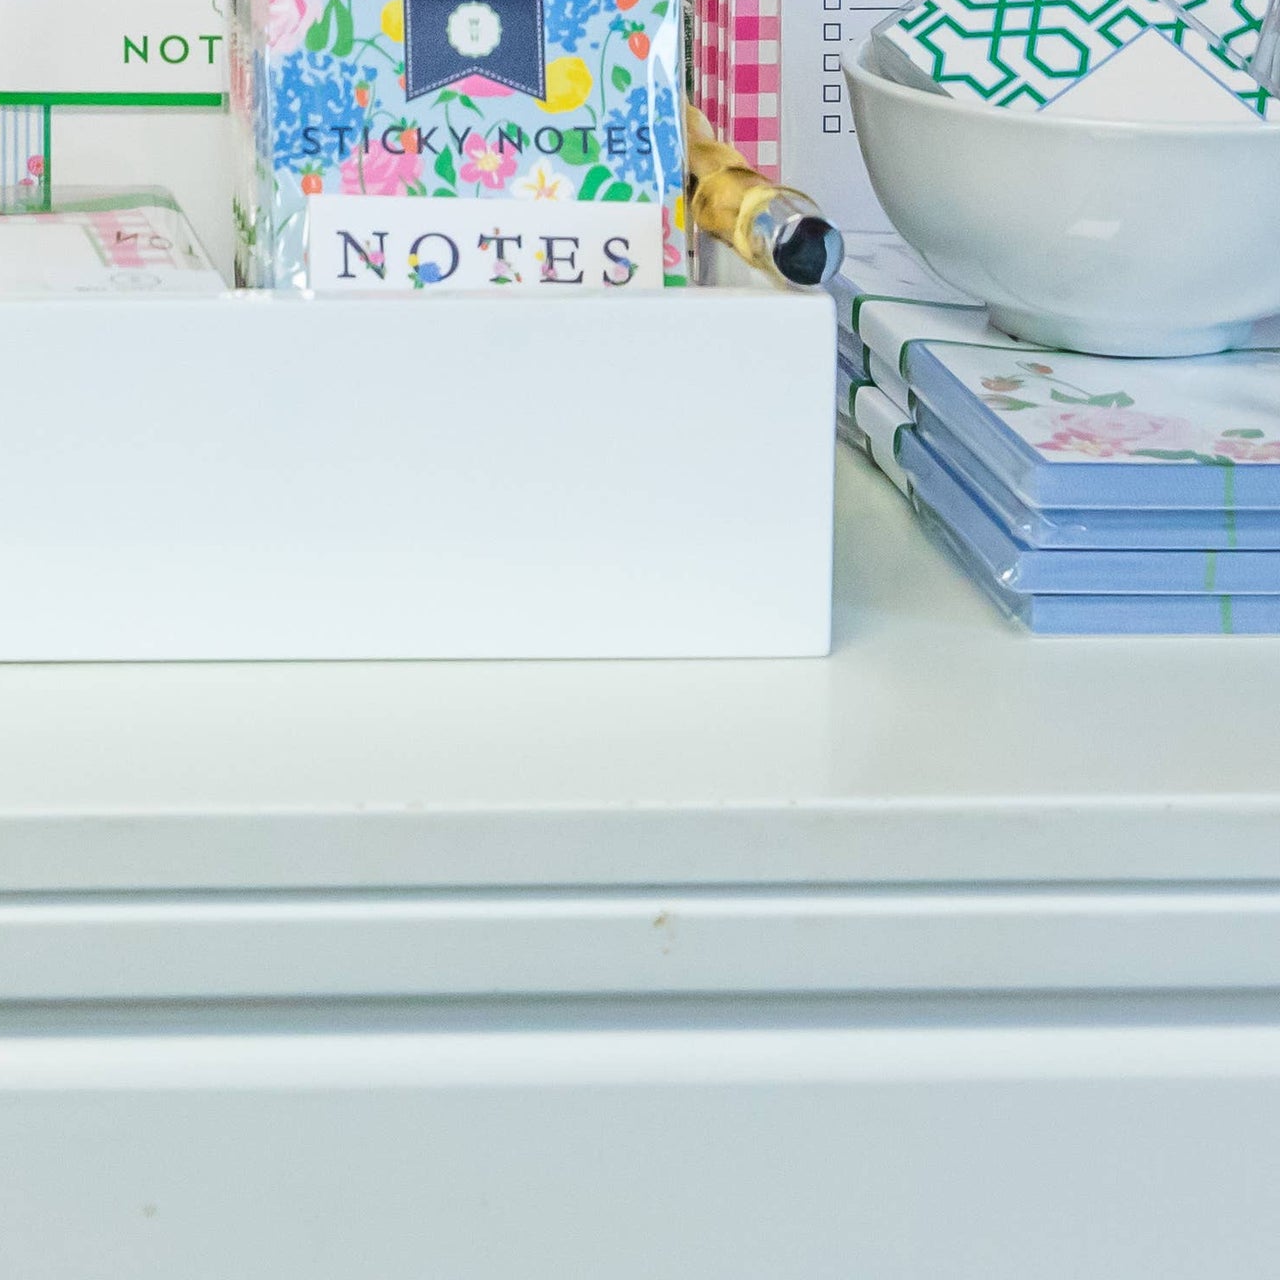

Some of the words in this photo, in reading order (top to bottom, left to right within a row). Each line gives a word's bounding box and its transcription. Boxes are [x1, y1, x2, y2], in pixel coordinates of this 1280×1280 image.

[302, 125, 472, 156] STICKY
[497, 125, 654, 157] NOTES
[336, 228, 635, 287] NOTES
